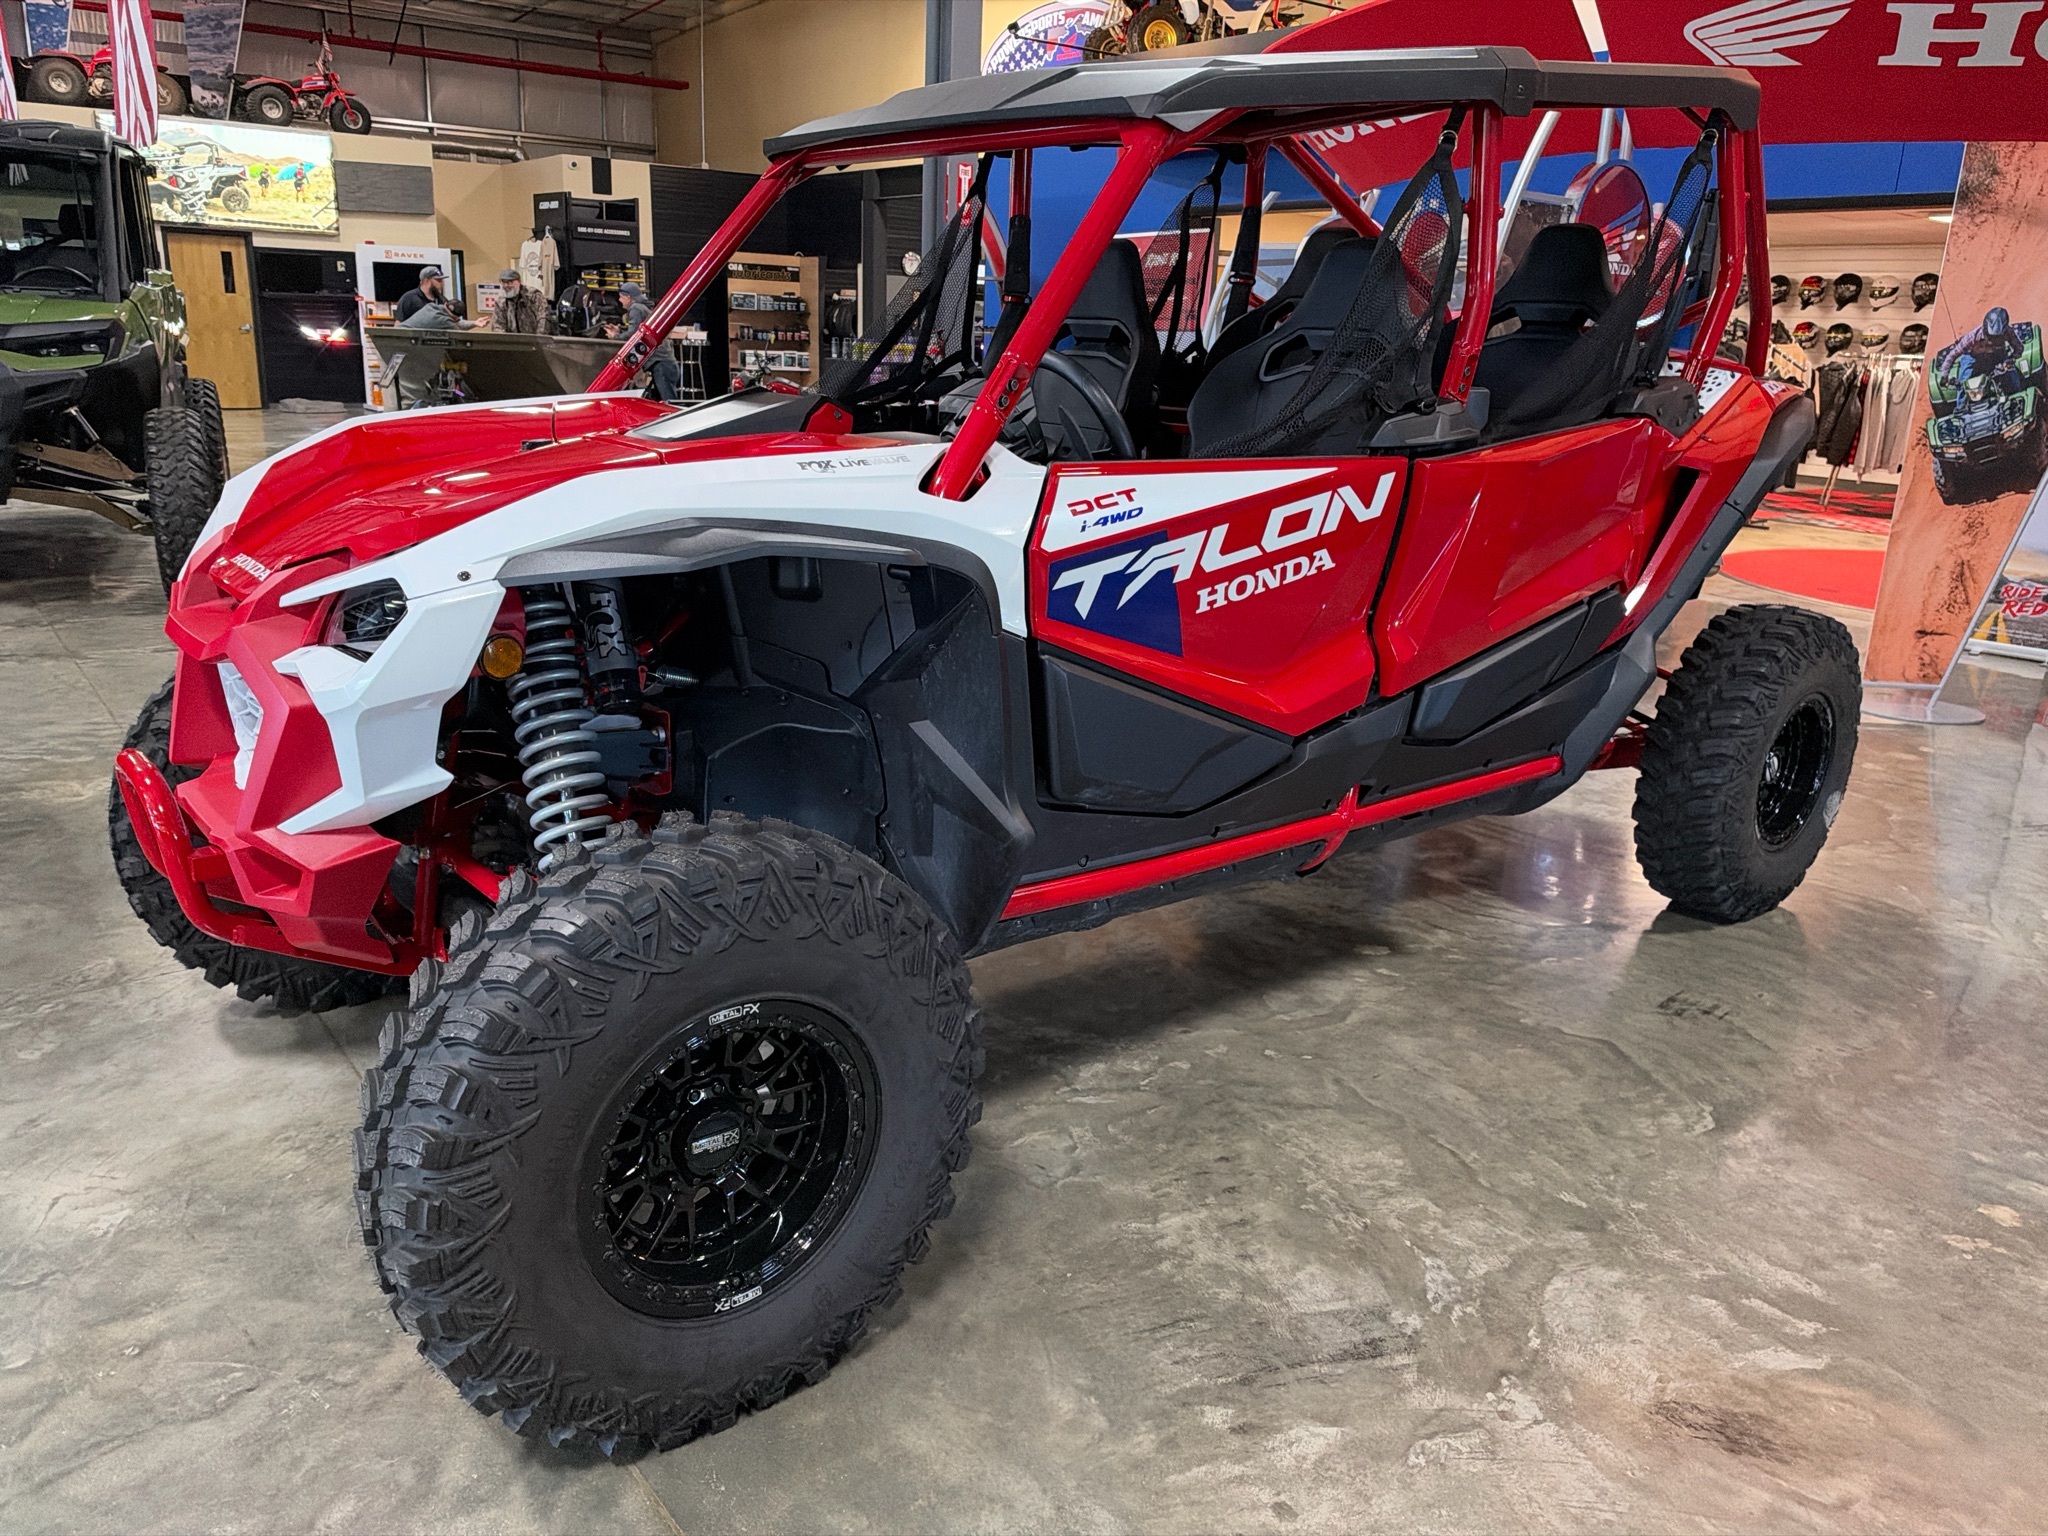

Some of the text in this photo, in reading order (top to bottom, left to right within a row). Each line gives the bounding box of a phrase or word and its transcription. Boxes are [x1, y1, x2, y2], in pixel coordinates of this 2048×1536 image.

[393, 251, 425, 259] RAVEK
[796, 459, 837, 474] FOX
[1066, 487, 1138, 517] DCT
[1079, 506, 1144, 533] i-4WD
[1052, 471, 1396, 620] TALON
[229, 552, 271, 582] HONDA
[1195, 548, 1336, 615] HONDA
[2001, 584, 2048, 599] RIDE
[2001, 599, 2048, 618] RED
[585, 590, 628, 659] FOX
[710, 1002, 760, 1024] METAL FX
[723, 1127, 740, 1142] FX
